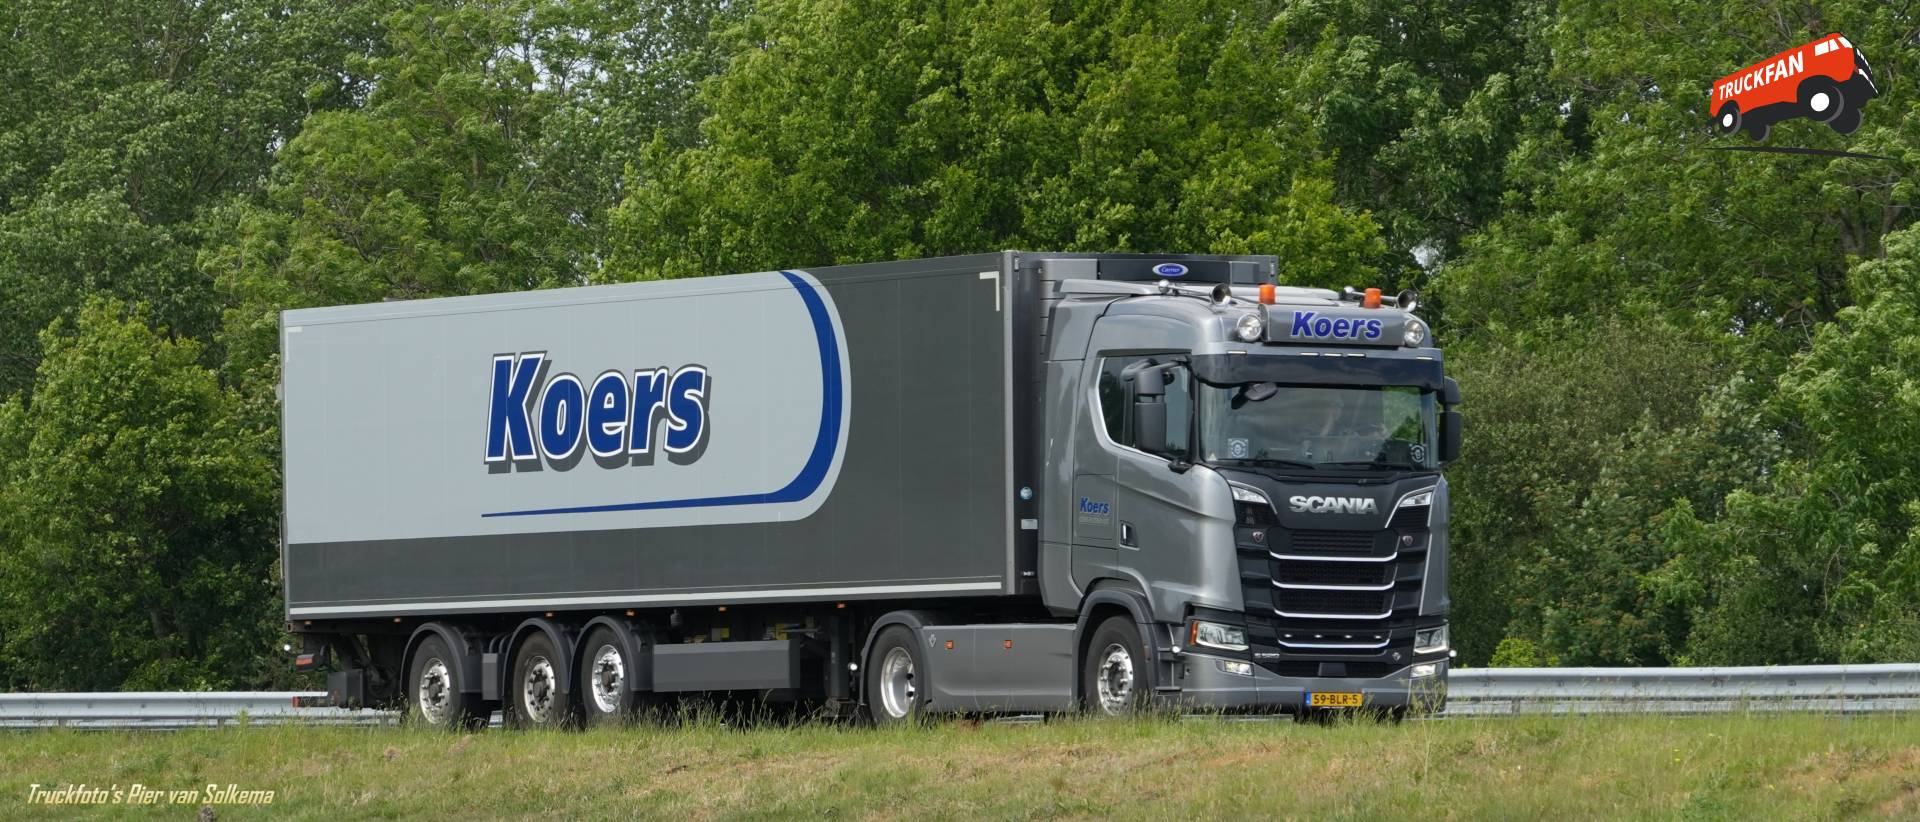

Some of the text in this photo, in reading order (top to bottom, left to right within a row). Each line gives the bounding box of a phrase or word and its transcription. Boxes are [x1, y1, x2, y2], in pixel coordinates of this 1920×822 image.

[1291, 310, 1383, 340] Koers
[484, 350, 712, 474] Koers
[1079, 497, 1110, 514] Koers
[1289, 495, 1380, 515] SCANIA
[1313, 694, 1358, 705] 59-BLR-5
